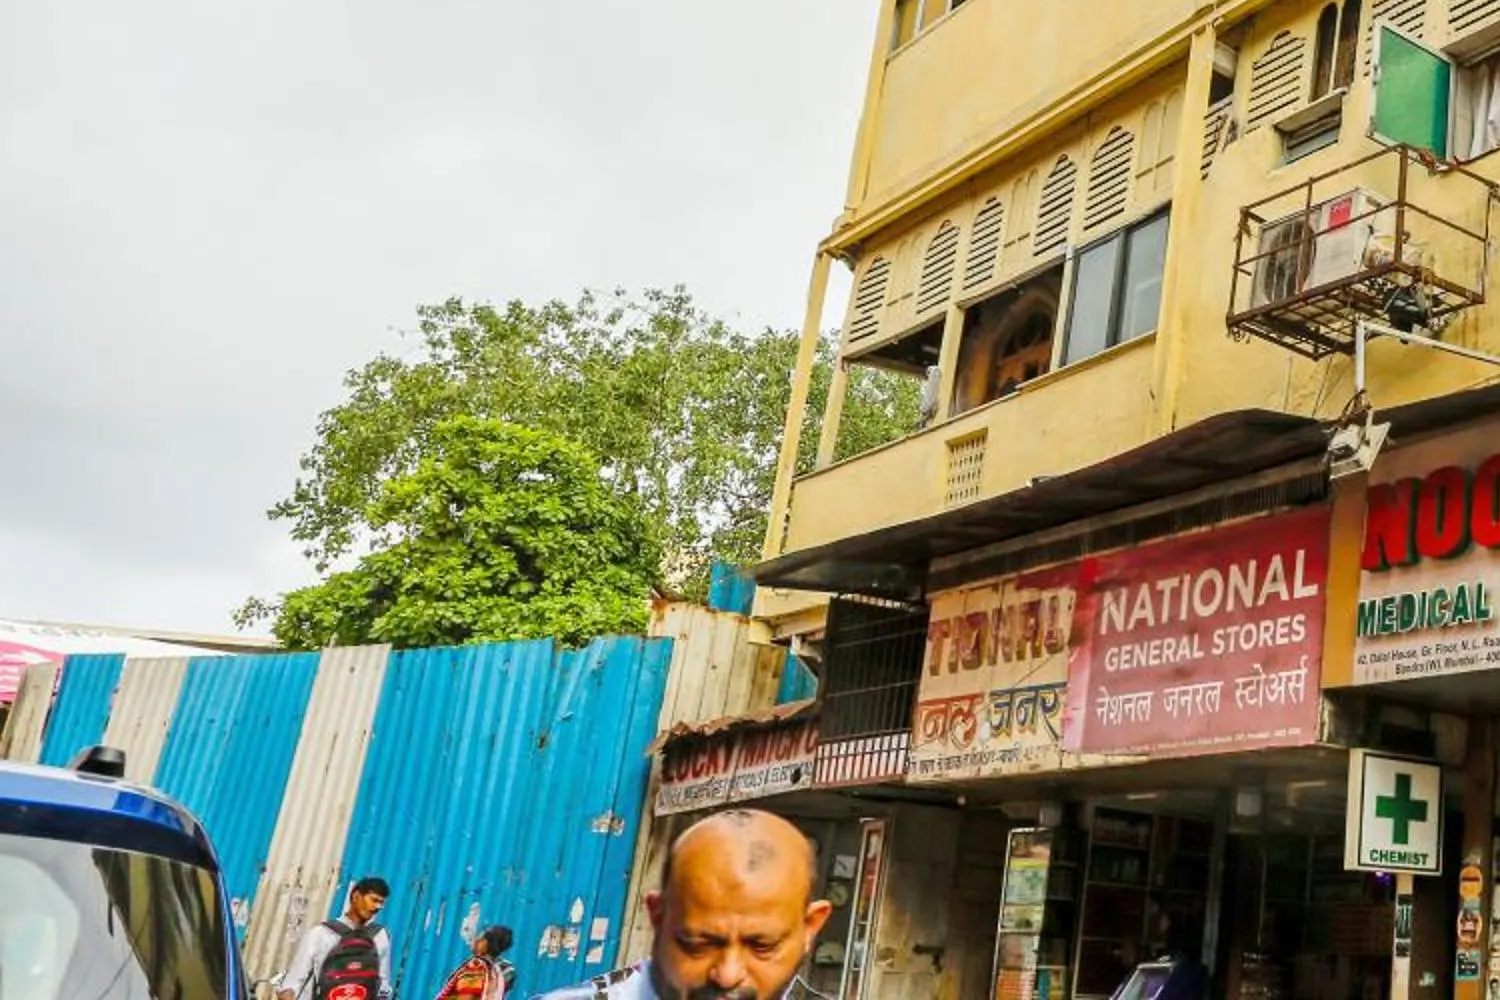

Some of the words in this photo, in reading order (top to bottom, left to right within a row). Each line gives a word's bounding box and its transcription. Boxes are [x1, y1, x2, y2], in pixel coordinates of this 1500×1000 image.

[1101, 550, 1318, 634] NATIONAL
[1357, 583, 1490, 637] MEDICAL
[1105, 634, 1204, 672] GENERAL
[1212, 614, 1305, 655] STORES
[1096, 684, 1154, 726] नेशनल
[1162, 680, 1225, 719] जनरल
[1370, 850, 1428, 865] CHEMIST
